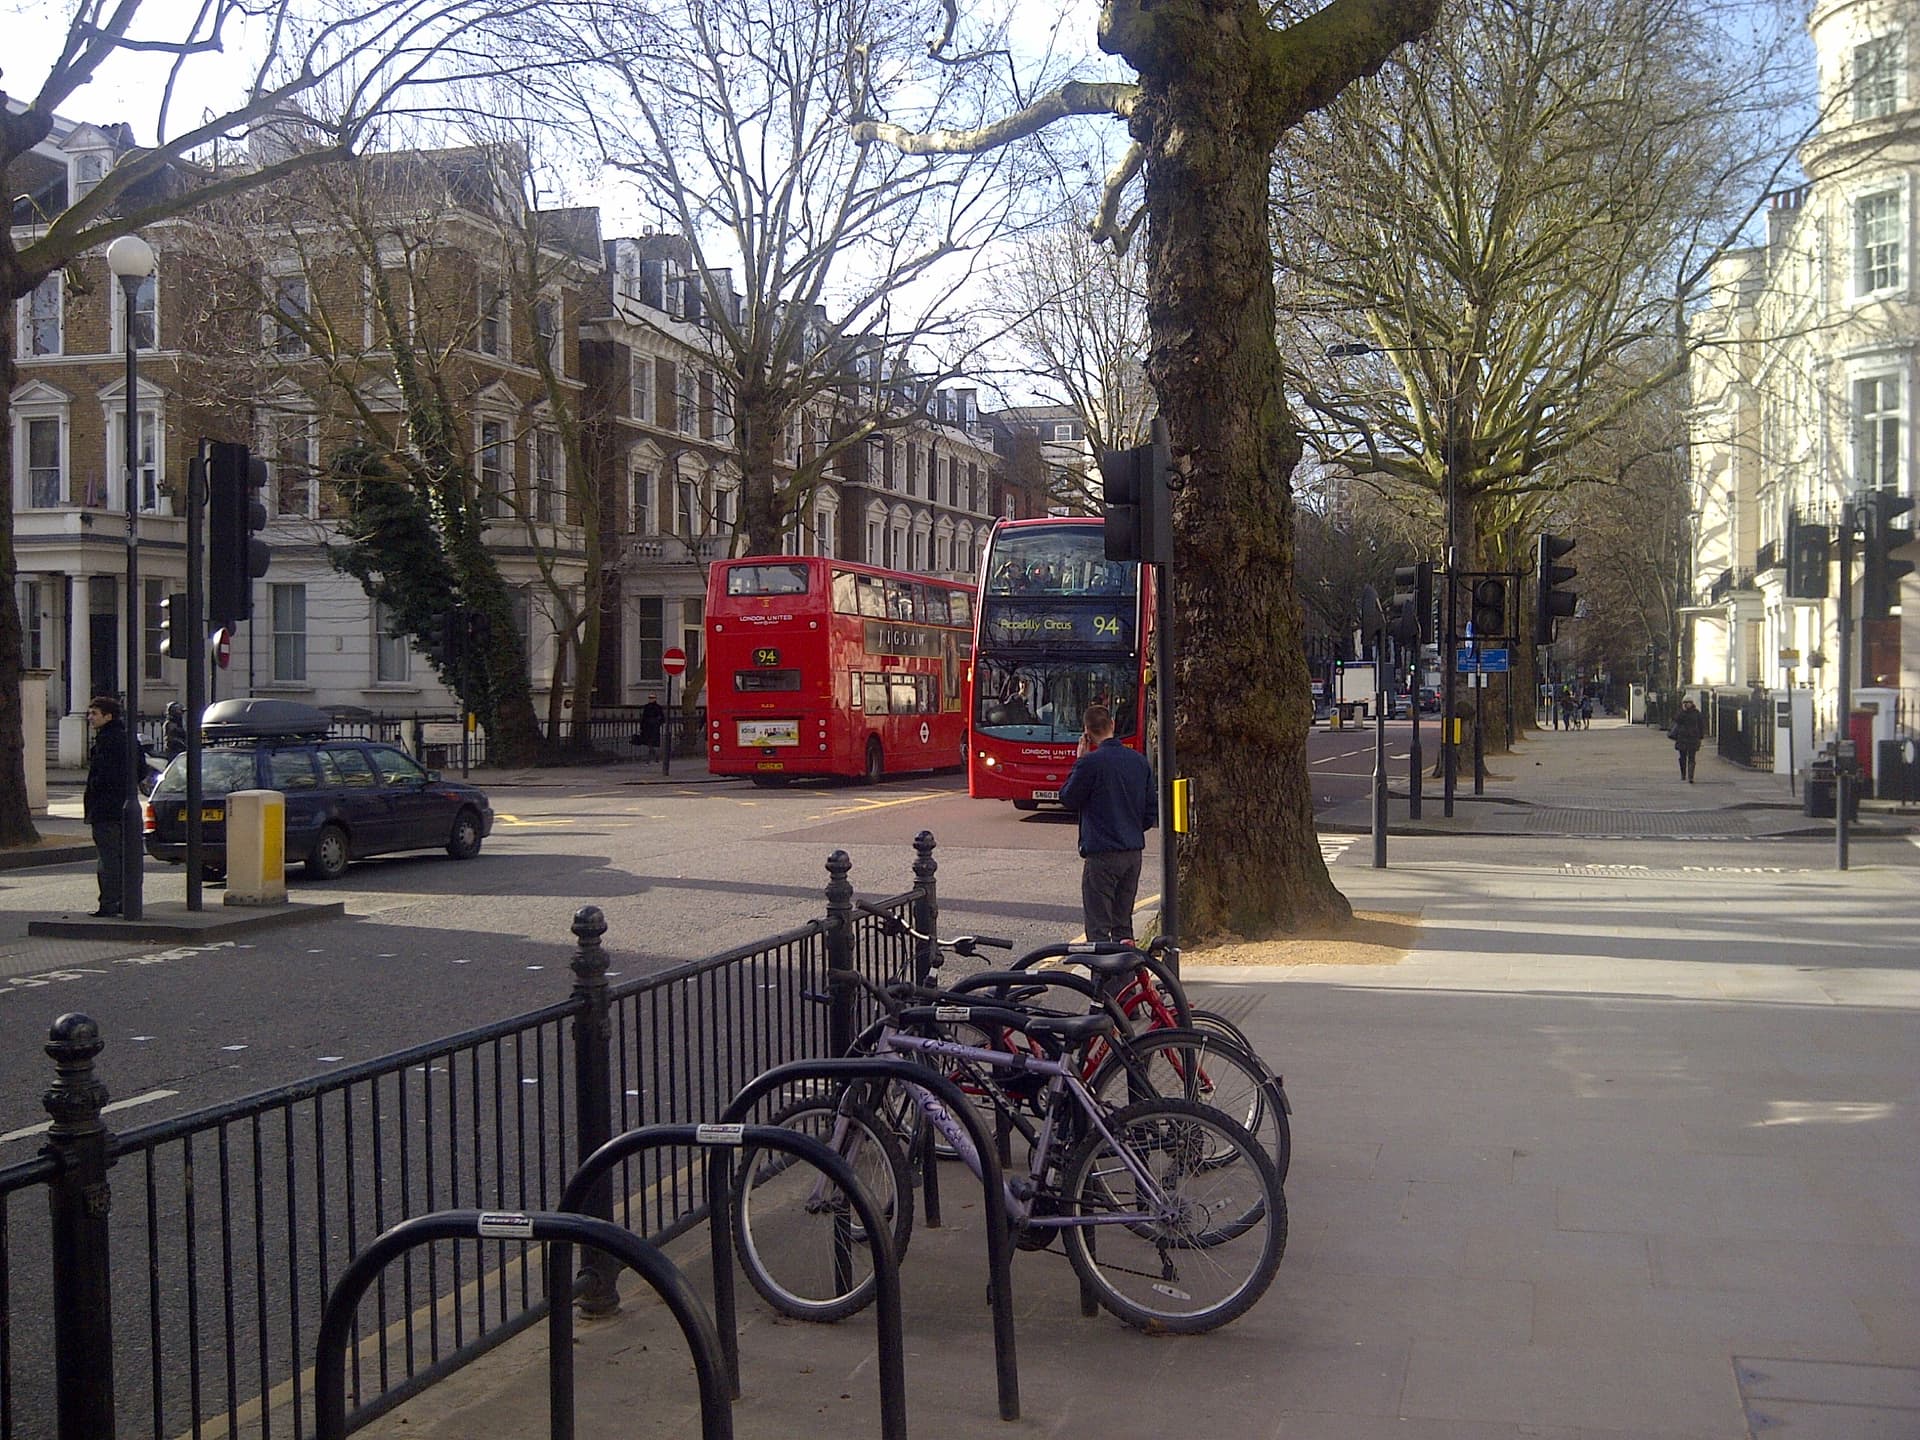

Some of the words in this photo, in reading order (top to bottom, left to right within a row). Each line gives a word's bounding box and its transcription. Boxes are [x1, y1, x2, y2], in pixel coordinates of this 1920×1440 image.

[1044, 619, 1072, 630] Circus
[1093, 616, 1119, 635] 94
[879, 628, 925, 649] JIGSAW
[758, 649, 776, 662] 94
[1053, 749, 1078, 757] UNITE
